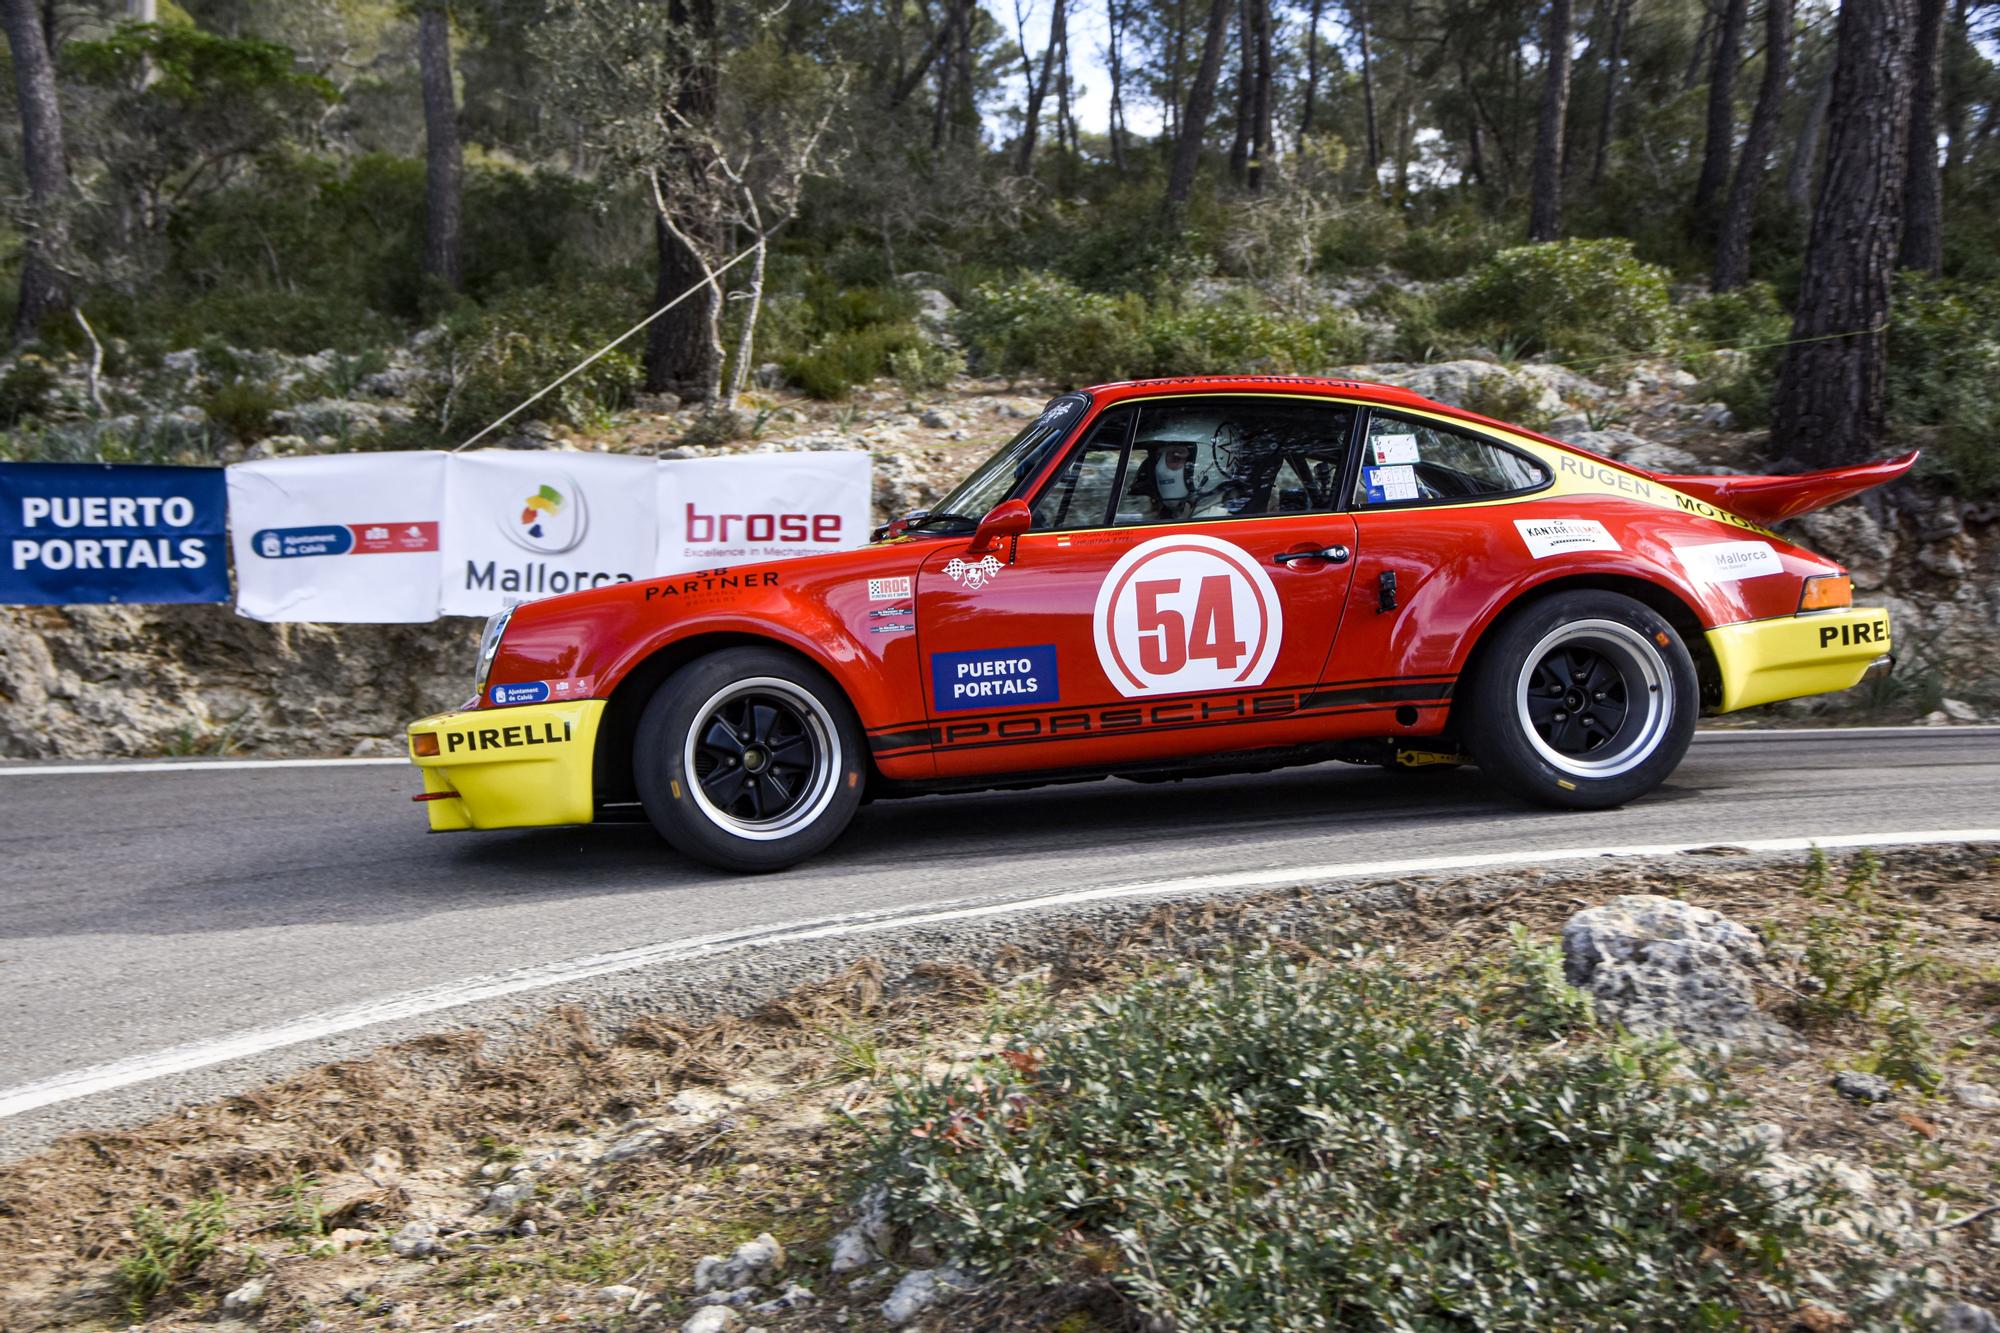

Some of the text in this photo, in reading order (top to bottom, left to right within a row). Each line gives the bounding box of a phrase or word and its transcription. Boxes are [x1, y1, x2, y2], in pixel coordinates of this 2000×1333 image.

[1560, 455, 1650, 497] RUGEN
[22, 497, 194, 528] PUERTO
[686, 503, 841, 542] brose
[12, 538, 207, 570] PORTALS
[684, 546, 744, 557] Excellence
[750, 546, 761, 556] in
[1715, 550, 1768, 565] Mallorca
[645, 572, 779, 601] PARTNER
[880, 578, 908, 593] IROC
[1135, 574, 1246, 675] 54
[957, 658, 1031, 678] PUERTO
[508, 687, 539, 695] Ajuntament
[953, 677, 1038, 698] PORTALS
[946, 693, 1296, 742] PORSCHE
[447, 721, 571, 752] PIRELLI
